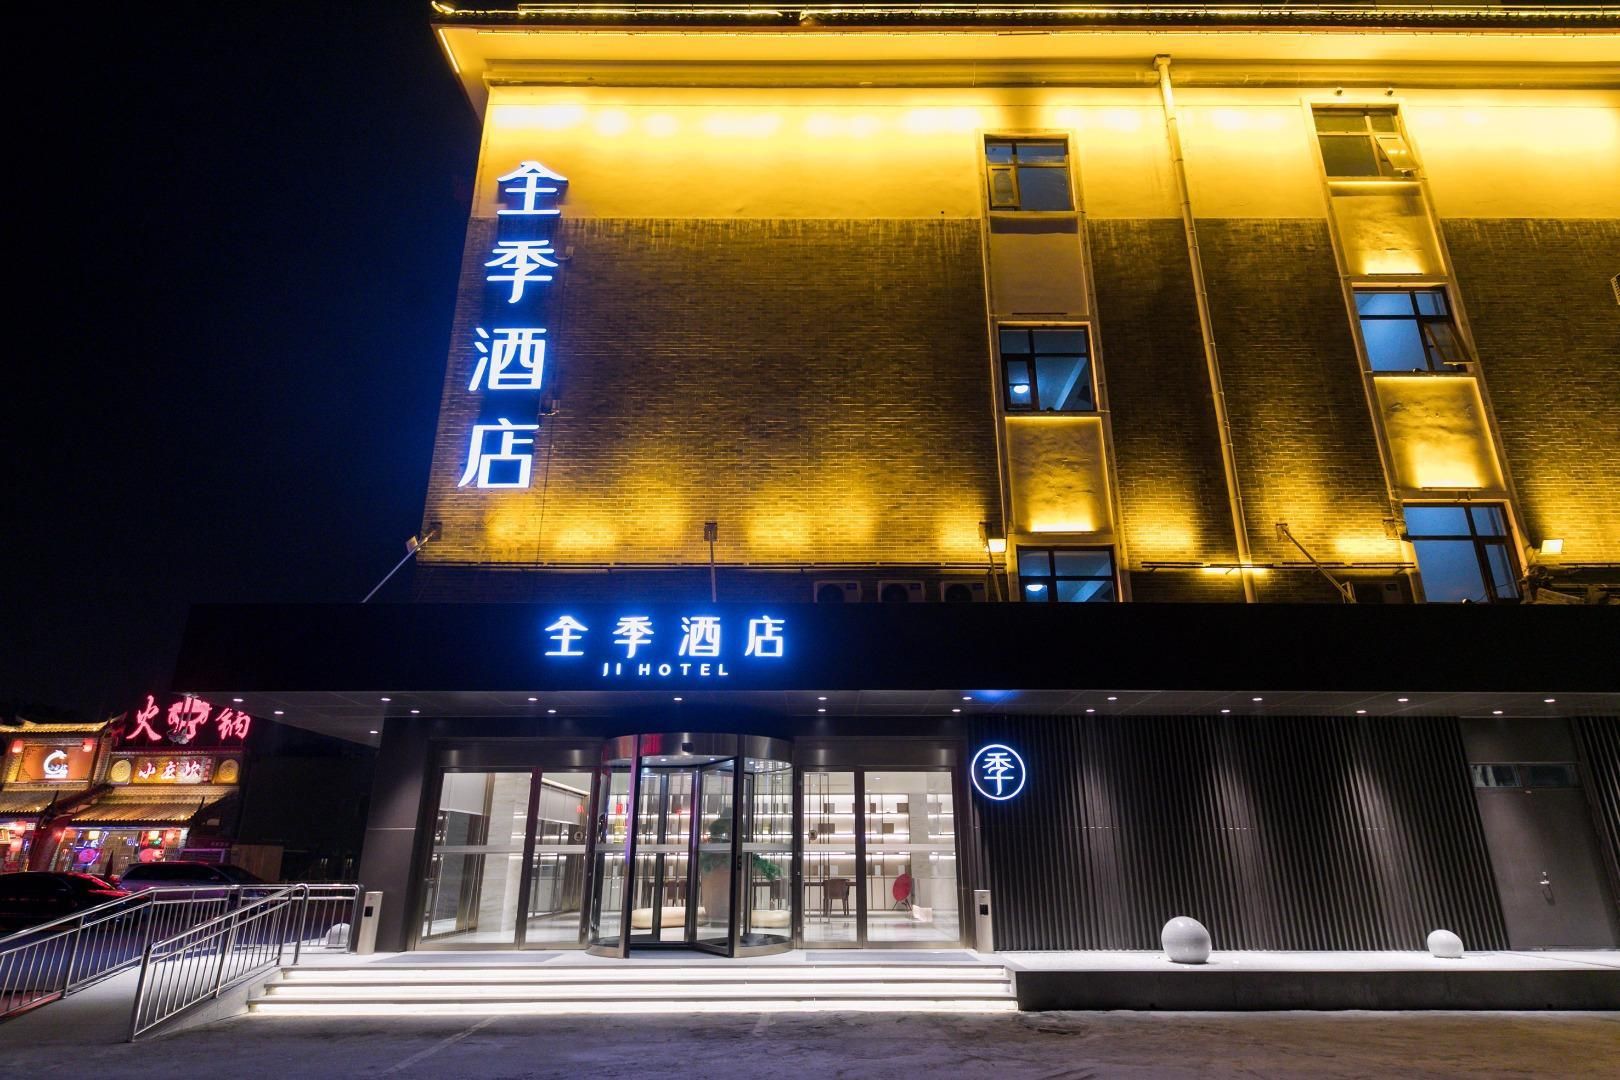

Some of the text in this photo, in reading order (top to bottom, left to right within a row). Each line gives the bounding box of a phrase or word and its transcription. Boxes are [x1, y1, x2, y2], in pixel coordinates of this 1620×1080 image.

[457, 160, 569, 489] 全季酒店
[544, 615, 785, 659] 全季酒店
[602, 662, 729, 677] JI HOTEL
[982, 752, 1015, 796] 季
